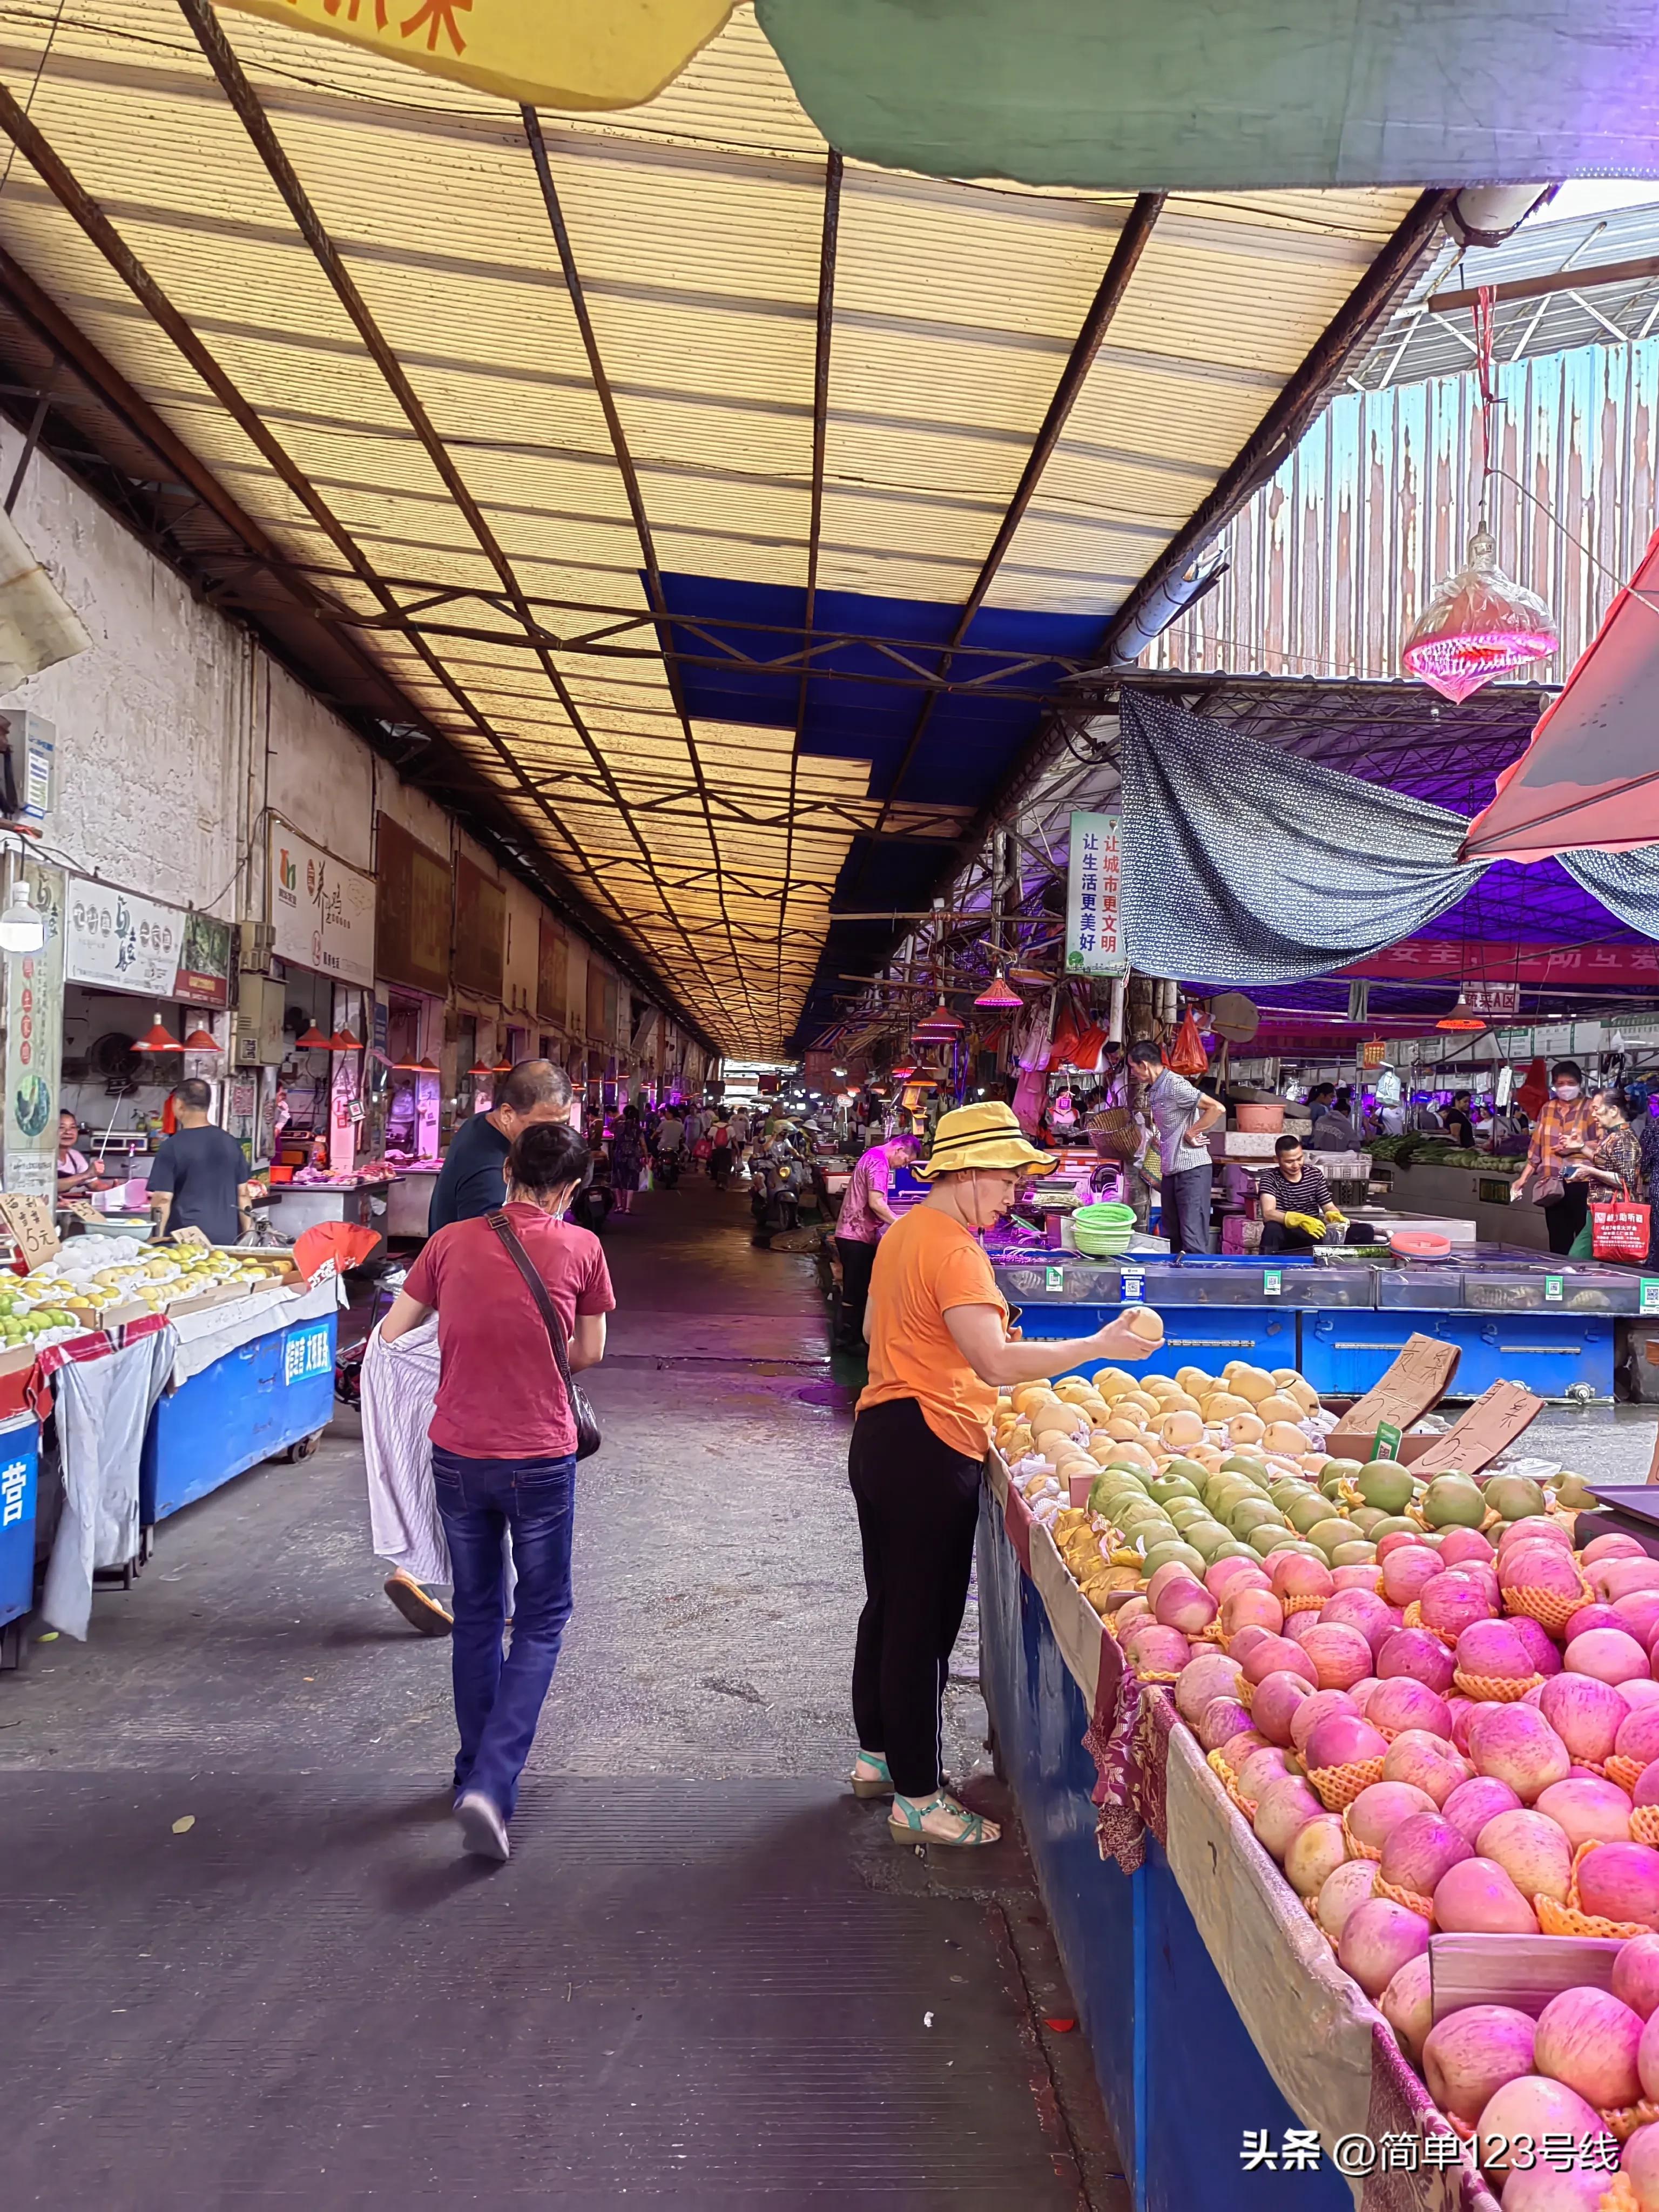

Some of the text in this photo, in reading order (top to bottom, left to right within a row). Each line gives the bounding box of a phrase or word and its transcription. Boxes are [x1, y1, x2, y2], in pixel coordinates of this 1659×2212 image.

[1080, 833, 1099, 952] 让生活更美好
[1101, 835, 1120, 953] 让城市更文明
[26, 1228, 55, 1251] 5元
[1421, 1422, 1474, 1469] 5元
